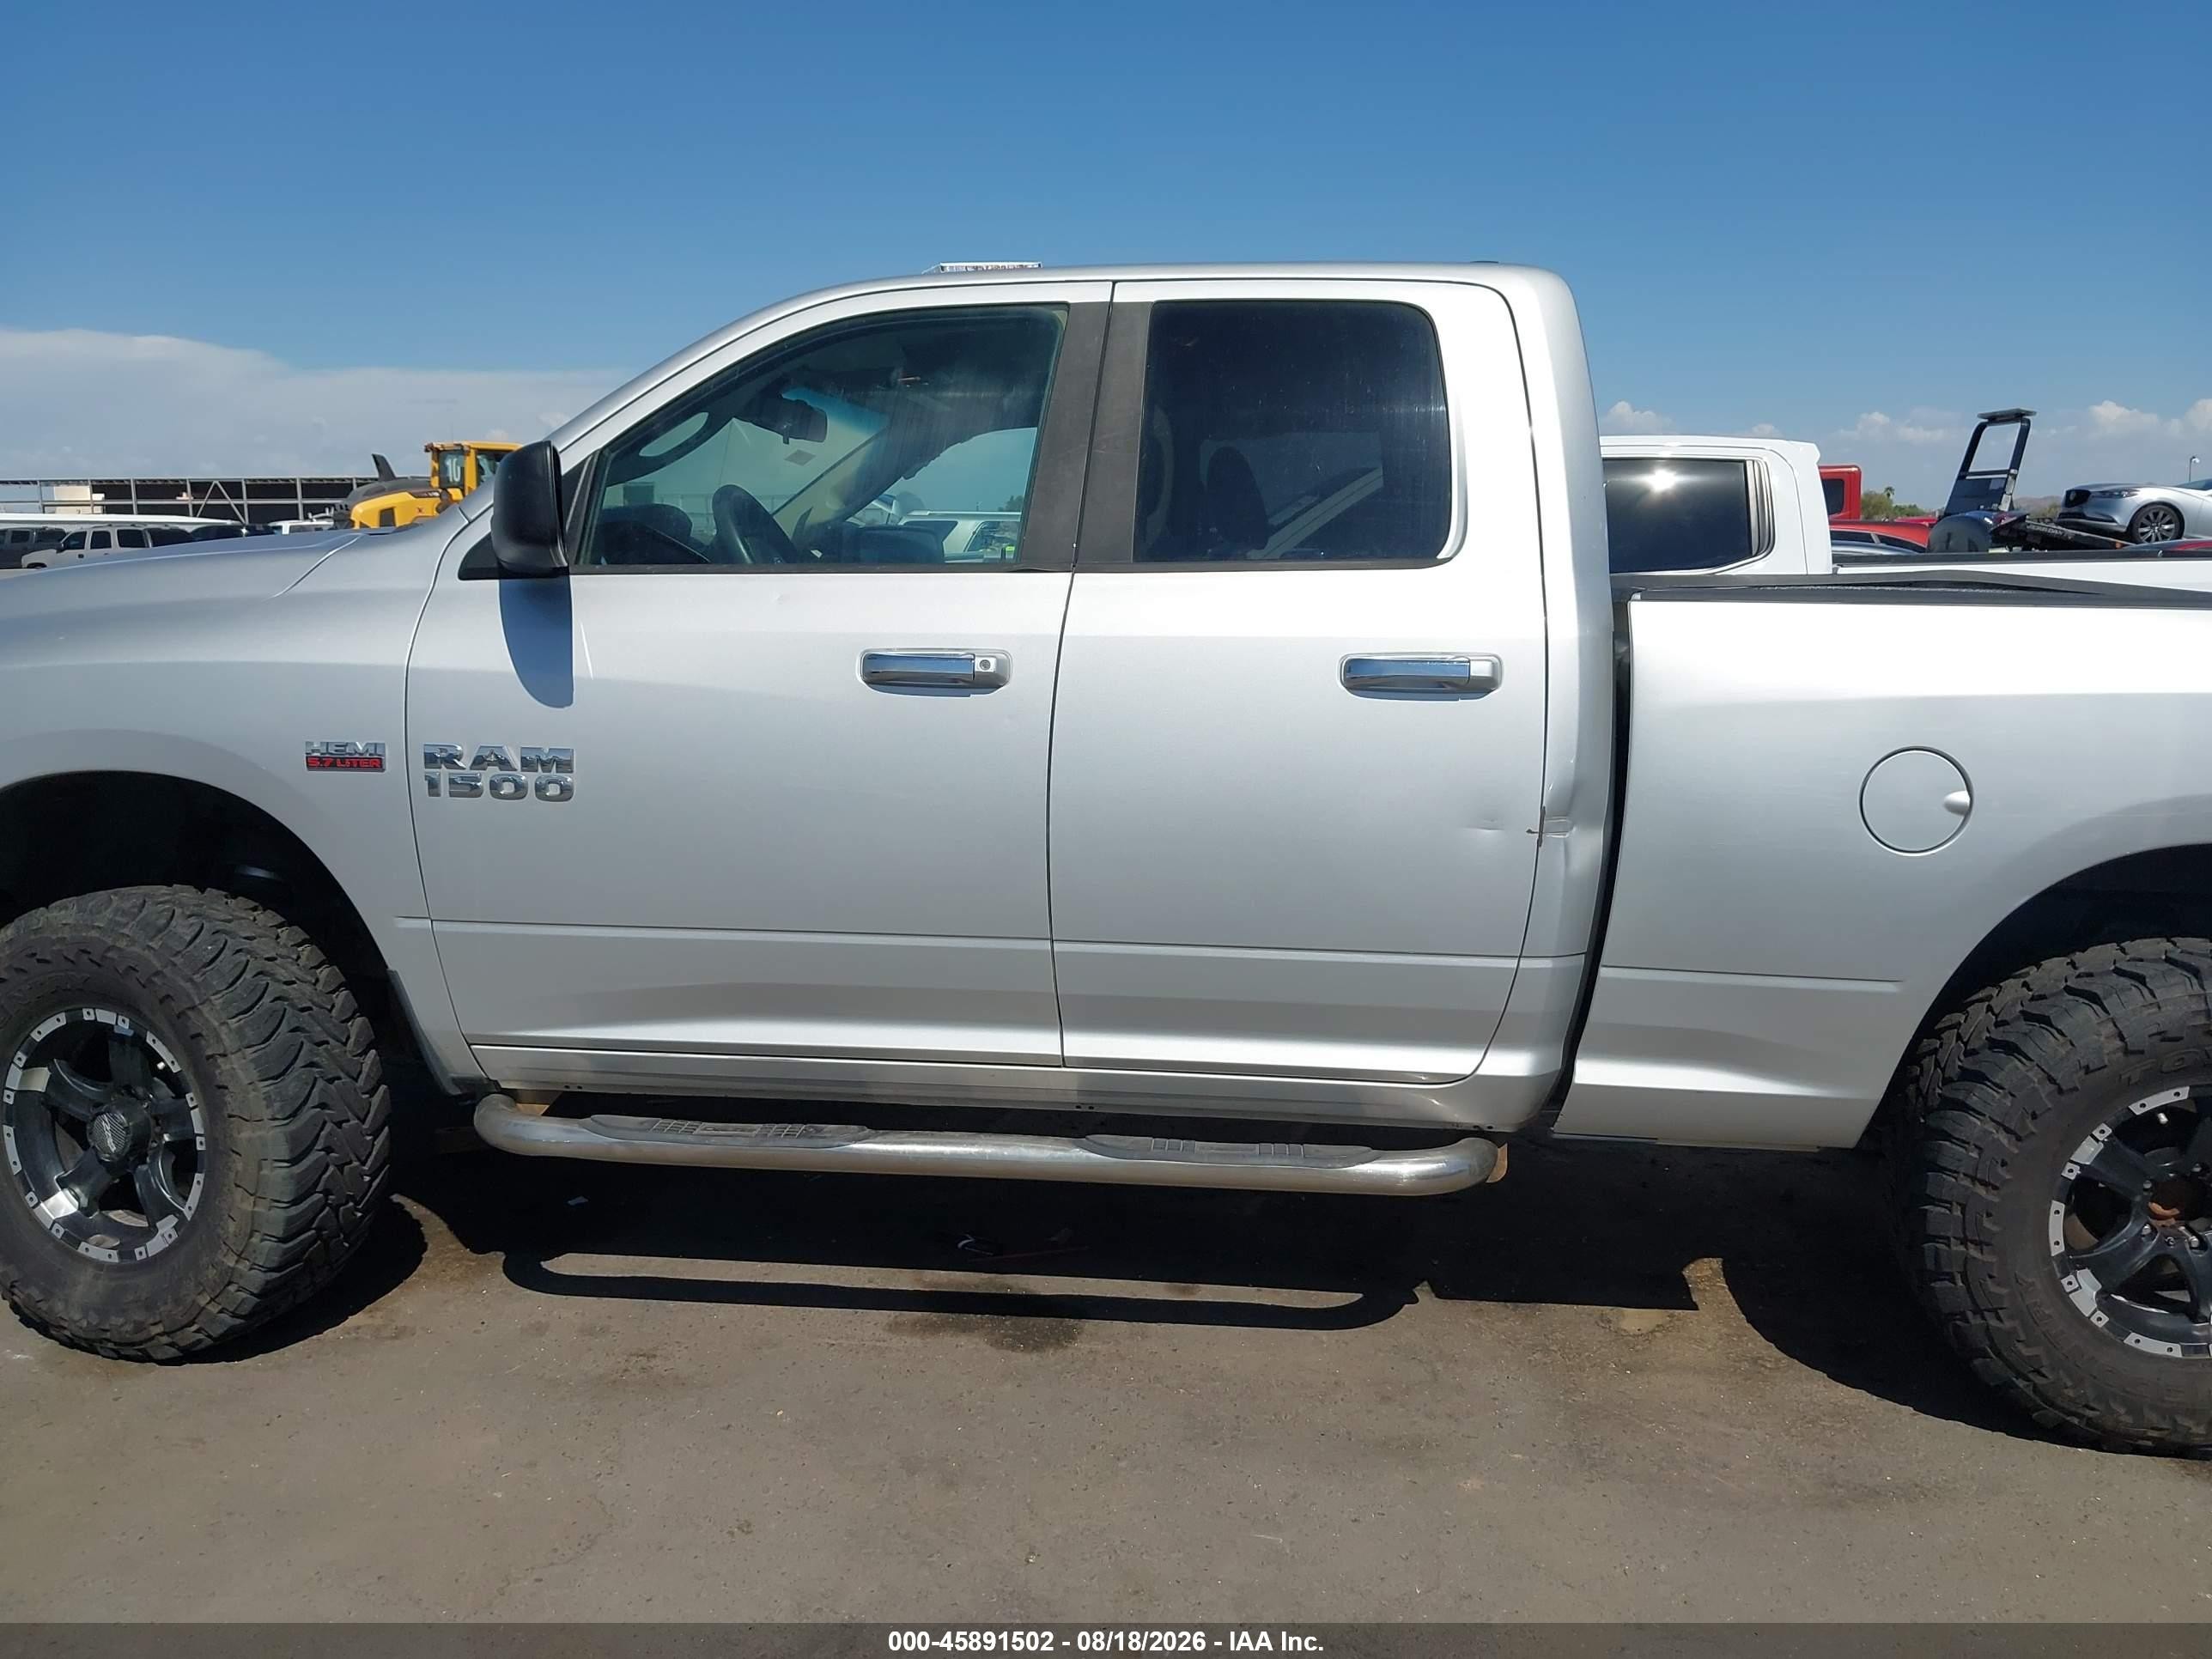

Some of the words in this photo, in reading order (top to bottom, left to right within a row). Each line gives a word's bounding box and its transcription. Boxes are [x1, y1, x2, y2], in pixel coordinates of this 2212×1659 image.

[305, 741, 386, 756] HEMI
[423, 743, 574, 774] RAM
[307, 757, 334, 768] 5.7
[336, 757, 381, 769] LITER
[424, 772, 574, 802] 1500
